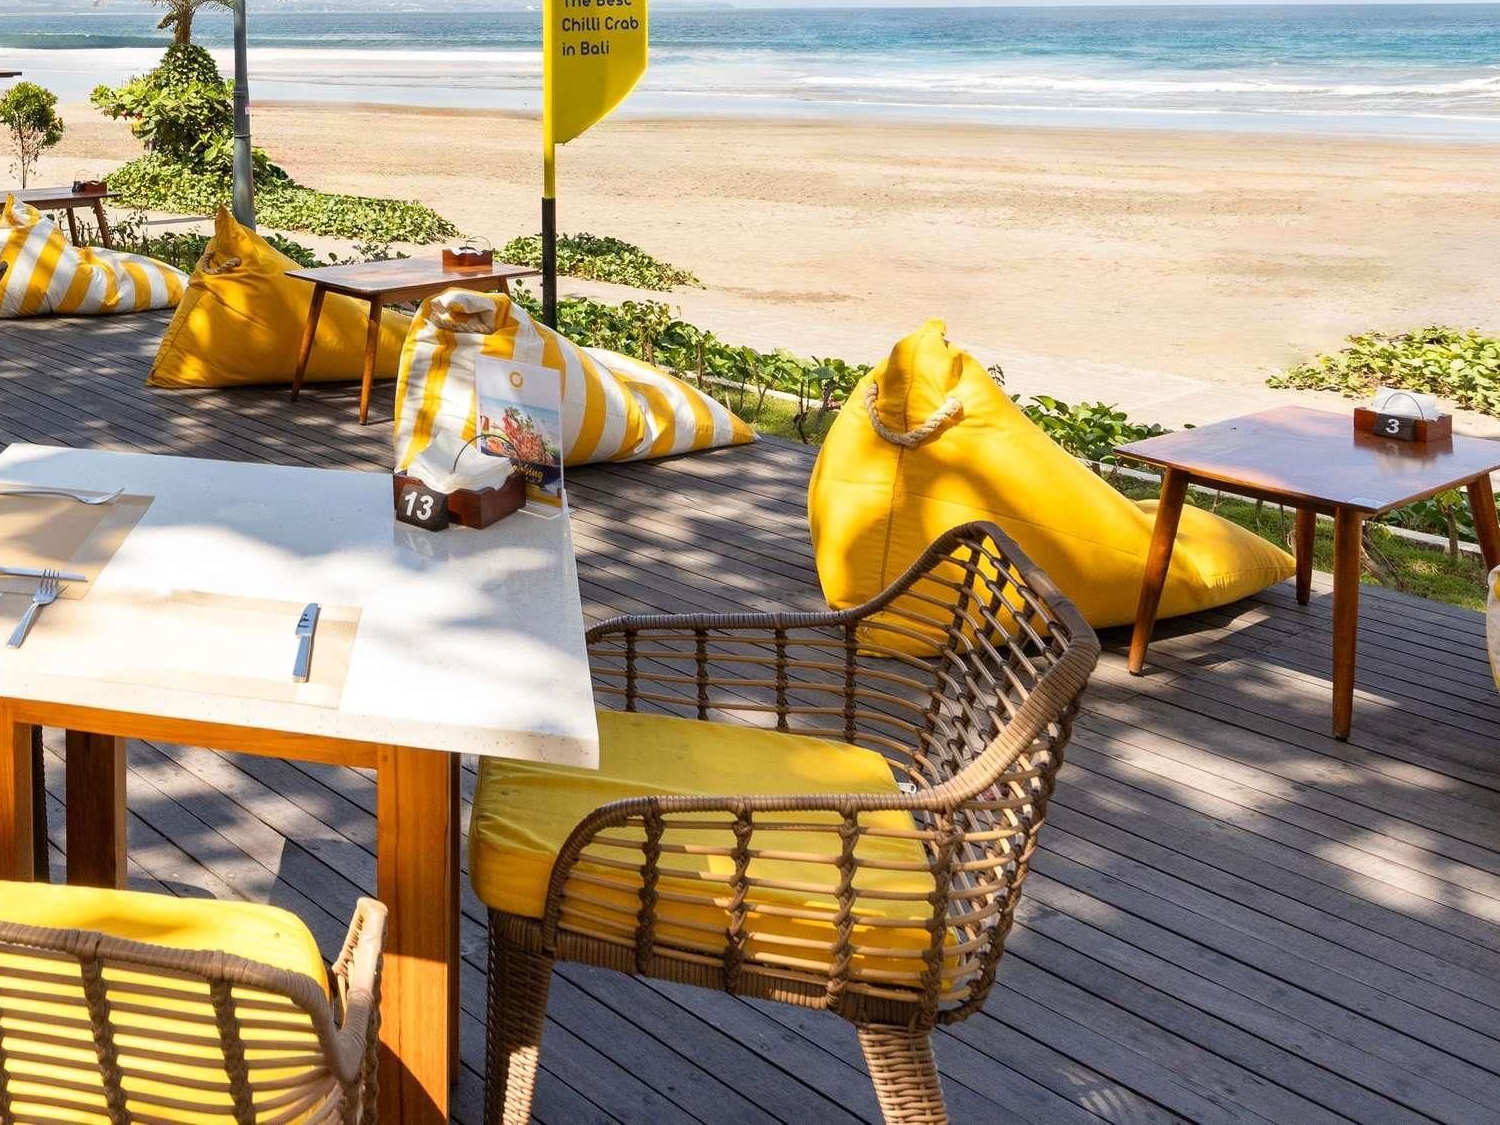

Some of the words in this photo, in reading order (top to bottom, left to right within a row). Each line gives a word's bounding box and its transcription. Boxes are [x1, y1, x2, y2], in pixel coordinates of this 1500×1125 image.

[562, 17, 600, 32] Chilli
[605, 16, 639, 30] Crab
[562, 42, 576, 56] in
[580, 40, 610, 55] Bali
[1385, 418, 1400, 434] 3
[404, 491, 435, 521] 13
